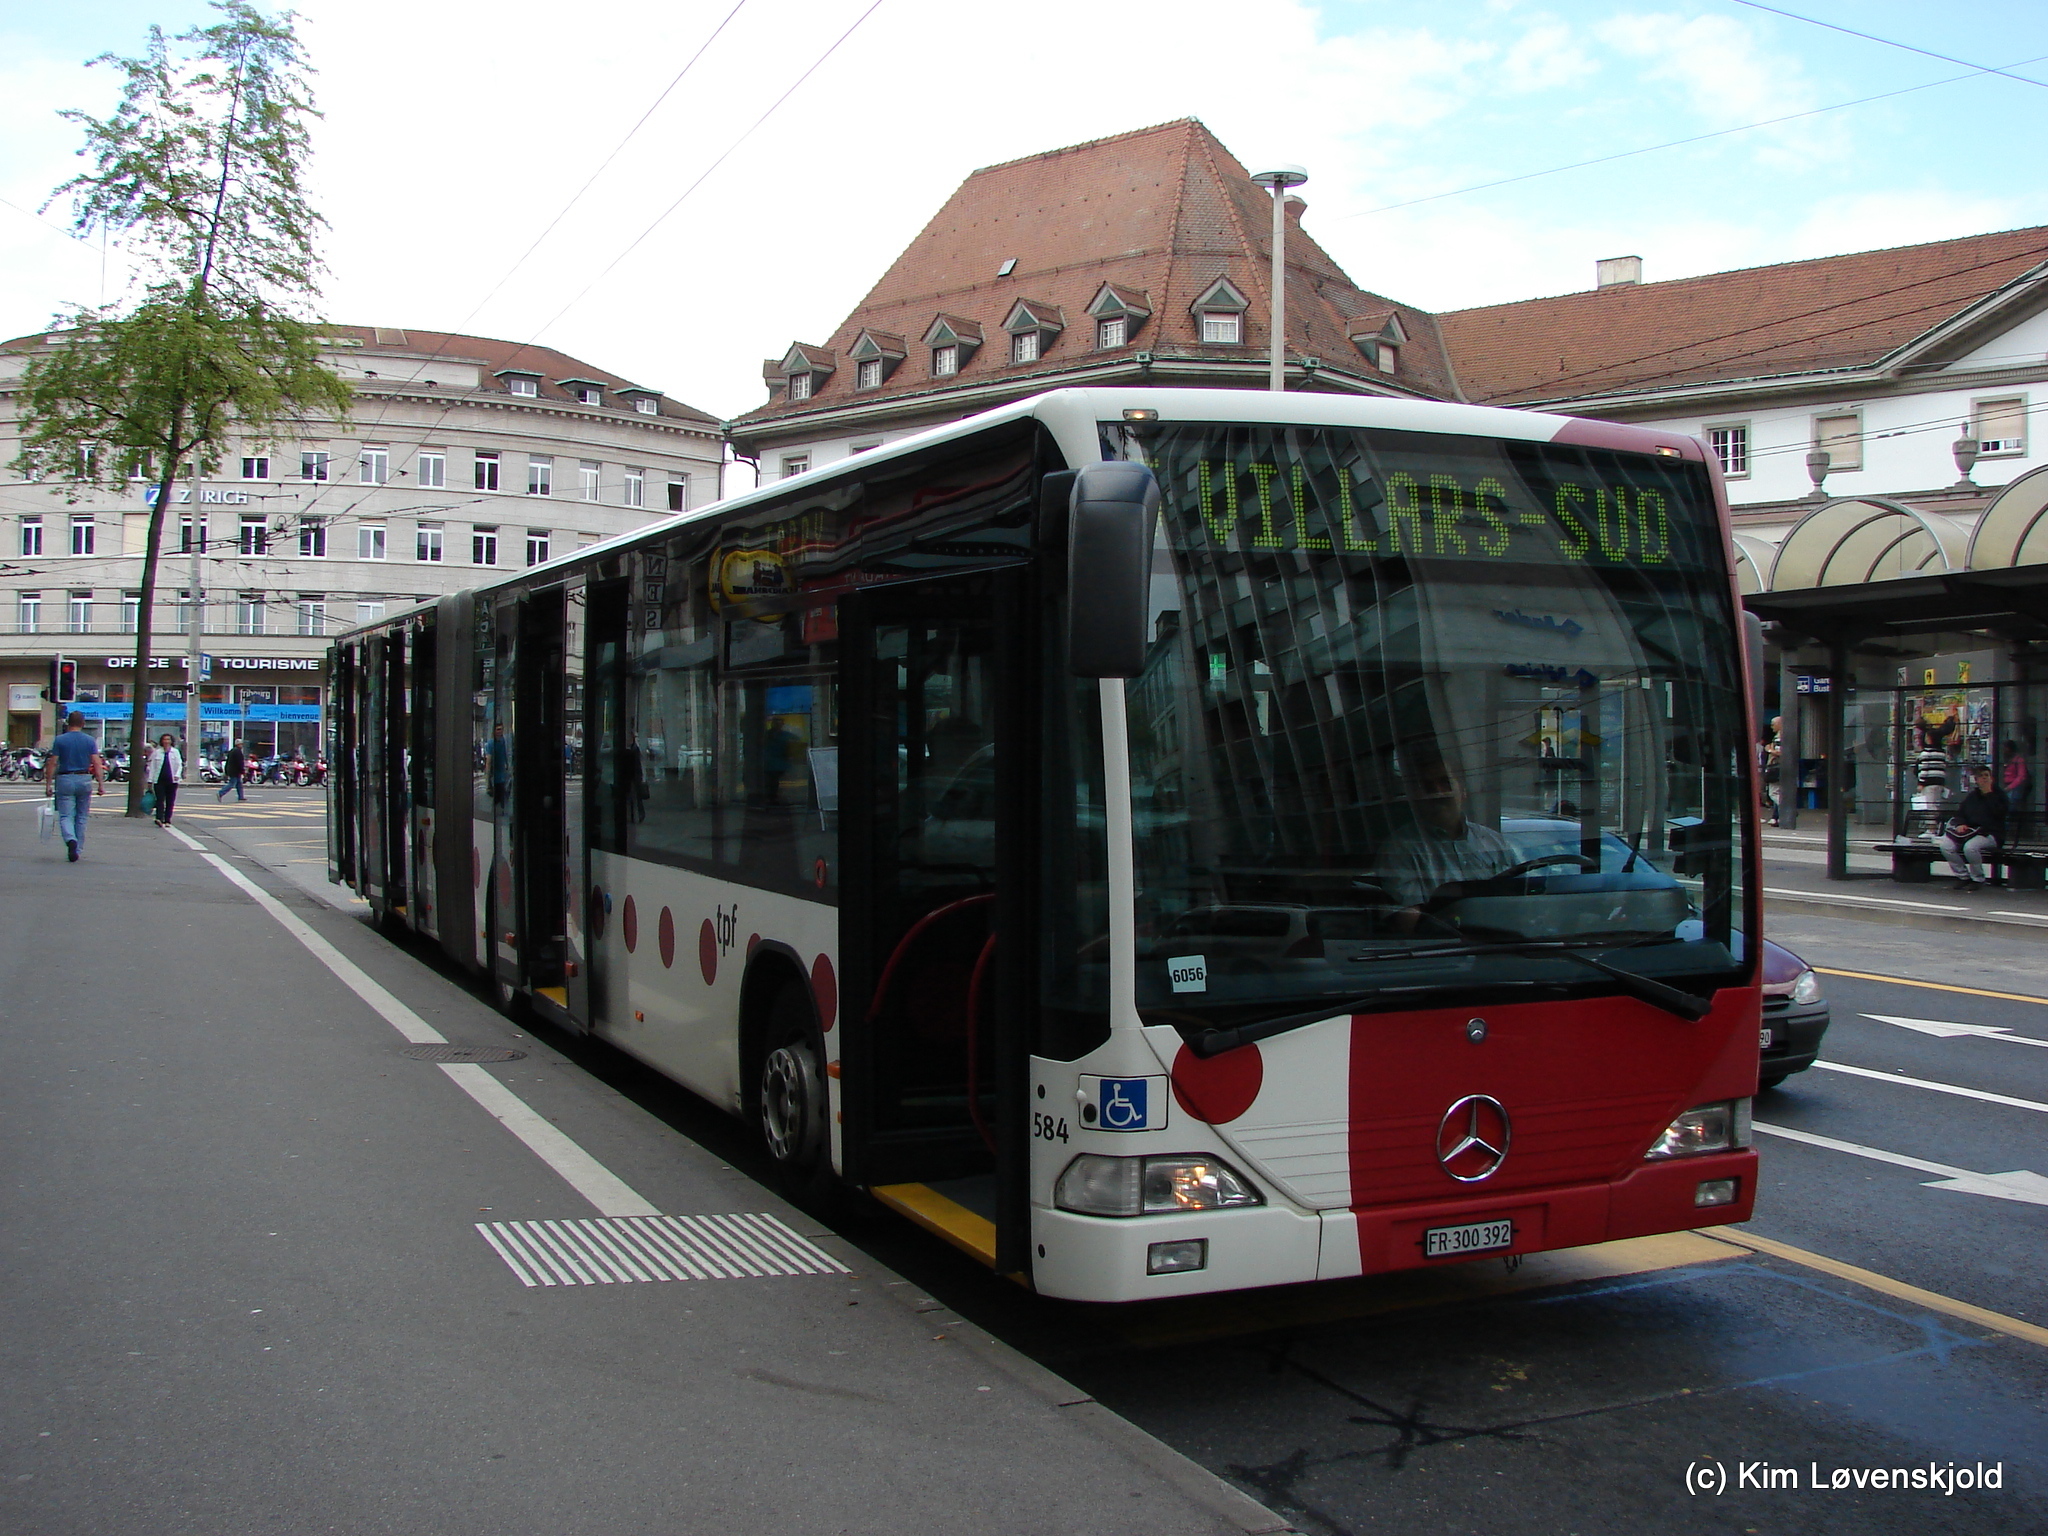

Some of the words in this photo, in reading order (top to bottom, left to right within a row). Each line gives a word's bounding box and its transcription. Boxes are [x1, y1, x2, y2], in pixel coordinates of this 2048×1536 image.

[107, 657, 170, 669] OFFCE
[220, 658, 320, 670] TOURISME
[716, 903, 737, 957] tpf
[1172, 966, 1204, 983] 6056
[1034, 1112, 1069, 1144] 584
